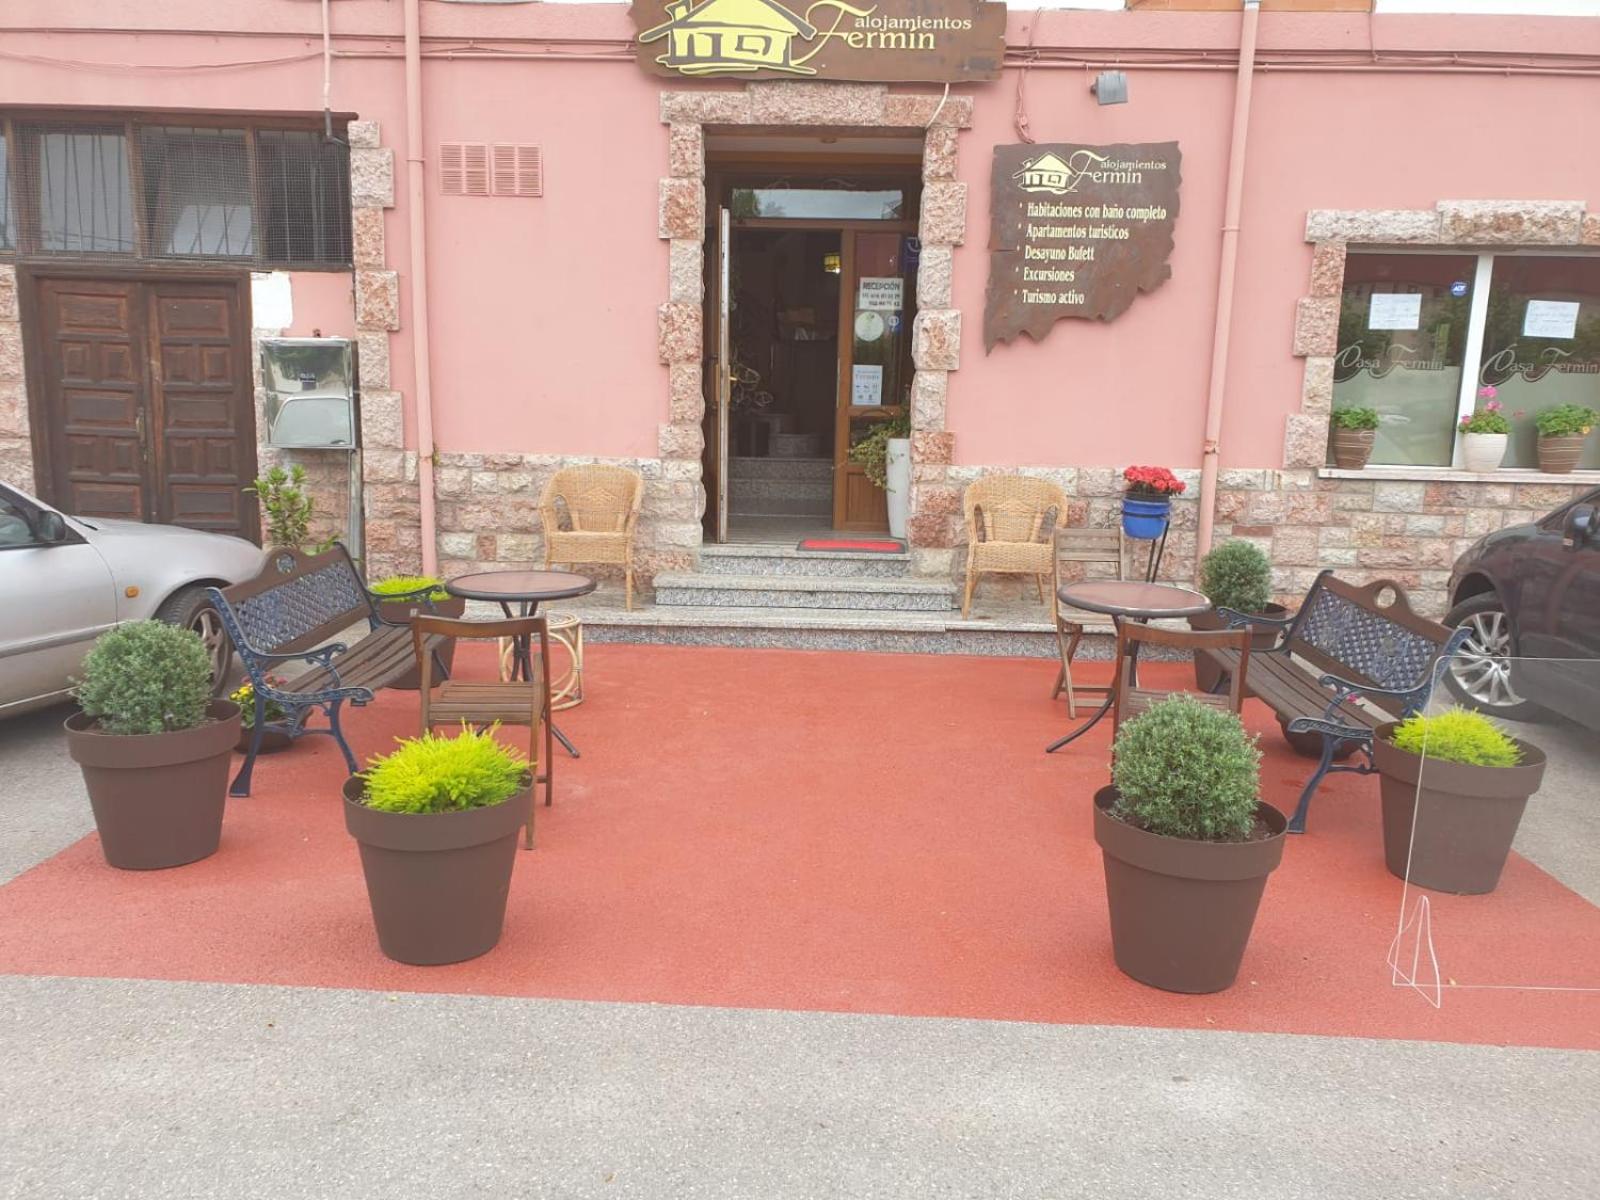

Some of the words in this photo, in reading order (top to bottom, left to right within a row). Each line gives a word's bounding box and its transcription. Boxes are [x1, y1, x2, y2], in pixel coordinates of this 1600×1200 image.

[854, 15, 972, 32] alojamientos
[1100, 160, 1167, 170] alojamientos
[1027, 202, 1082, 218] Habitaciones
[1084, 207, 1100, 218] con
[1102, 204, 1124, 218] baño
[1126, 205, 1167, 223] completo
[1026, 223, 1087, 241] Apartamentos
[1025, 245, 1066, 263] Desayuno
[1068, 245, 1095, 260] Bufett
[1023, 266, 1075, 281] Excursiones
[1022, 288, 1056, 304] Turismo
[1058, 288, 1085, 304] activo
[1480, 344, 1534, 387] Casa
